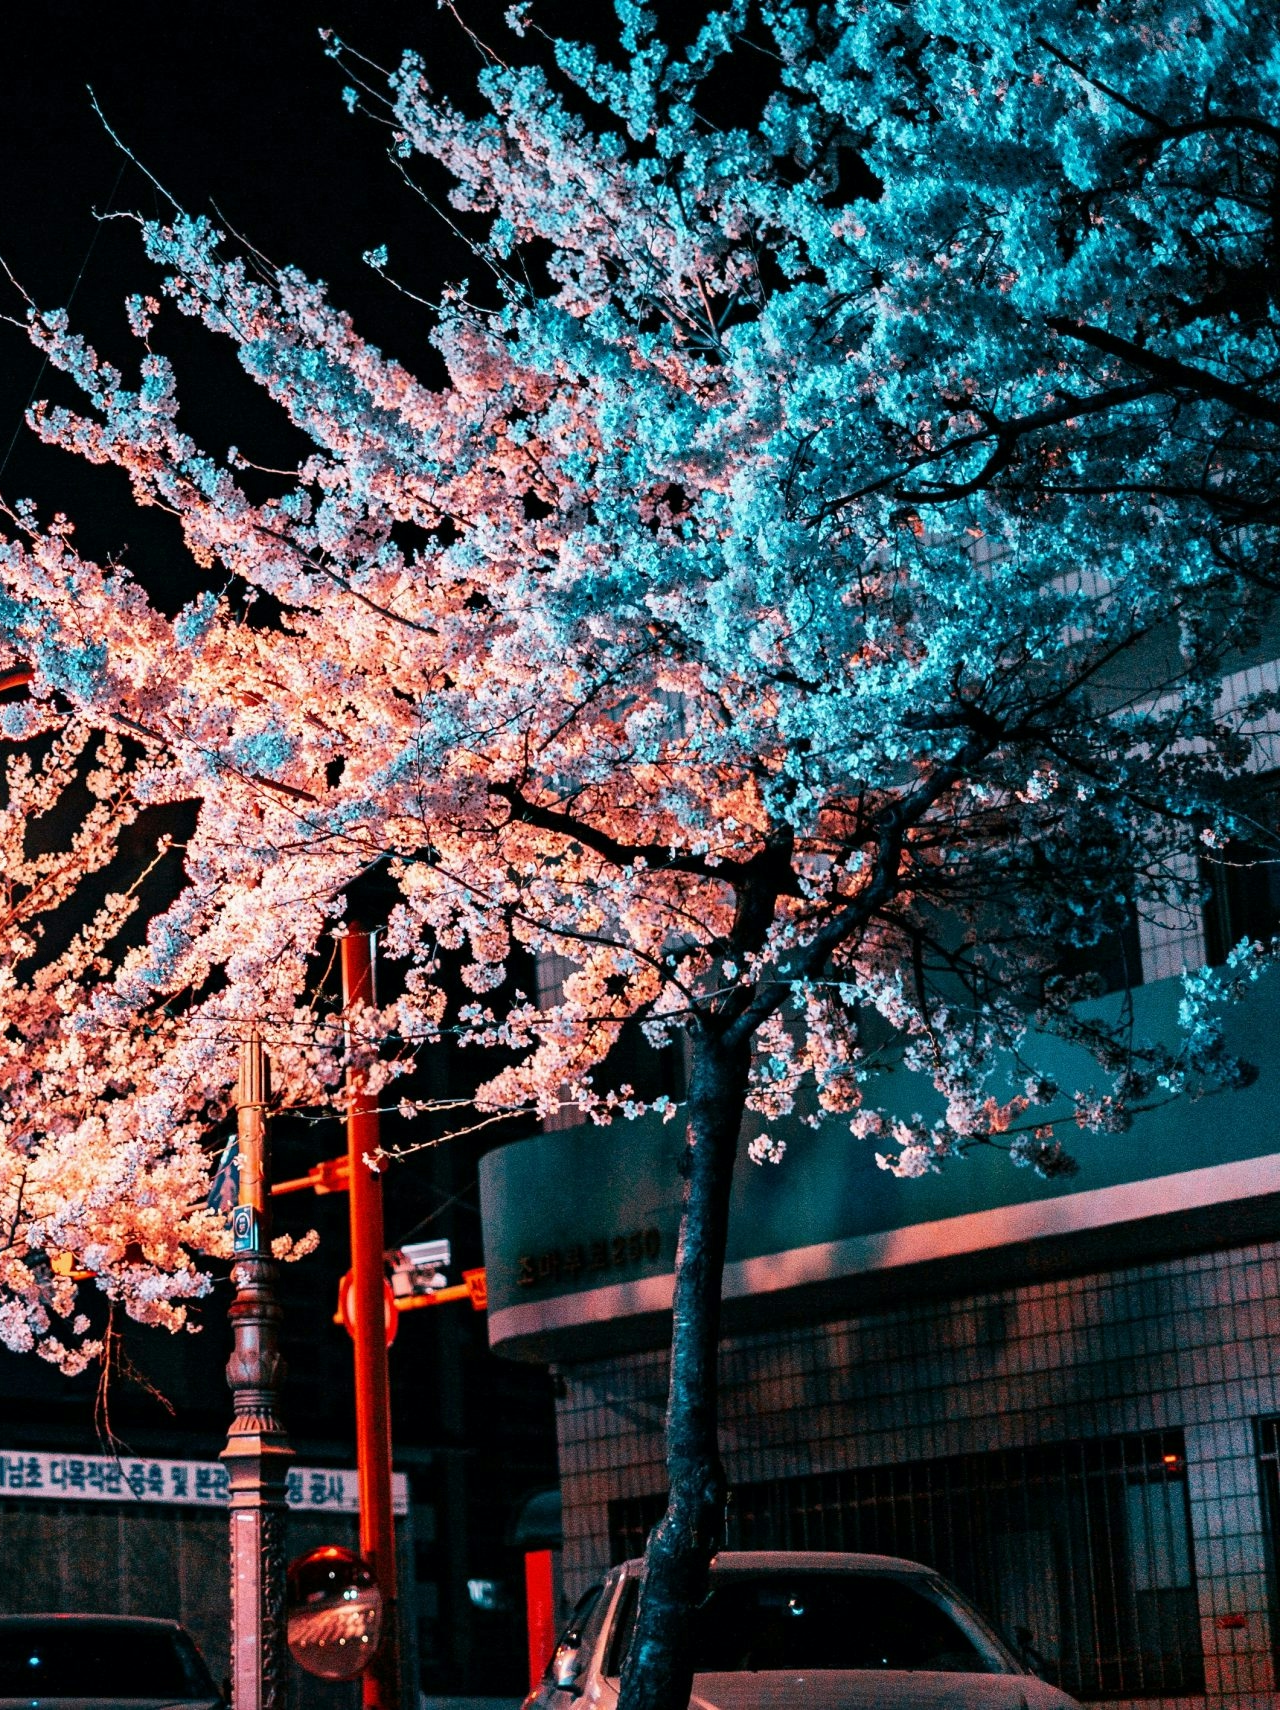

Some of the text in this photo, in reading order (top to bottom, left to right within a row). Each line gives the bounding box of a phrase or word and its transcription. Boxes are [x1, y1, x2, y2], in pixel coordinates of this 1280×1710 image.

[50, 1460, 122, 1493] 다목적관
[128, 1463, 163, 1496] 증축
[171, 1466, 187, 1497] 및
[309, 1473, 344, 1505] 공사
